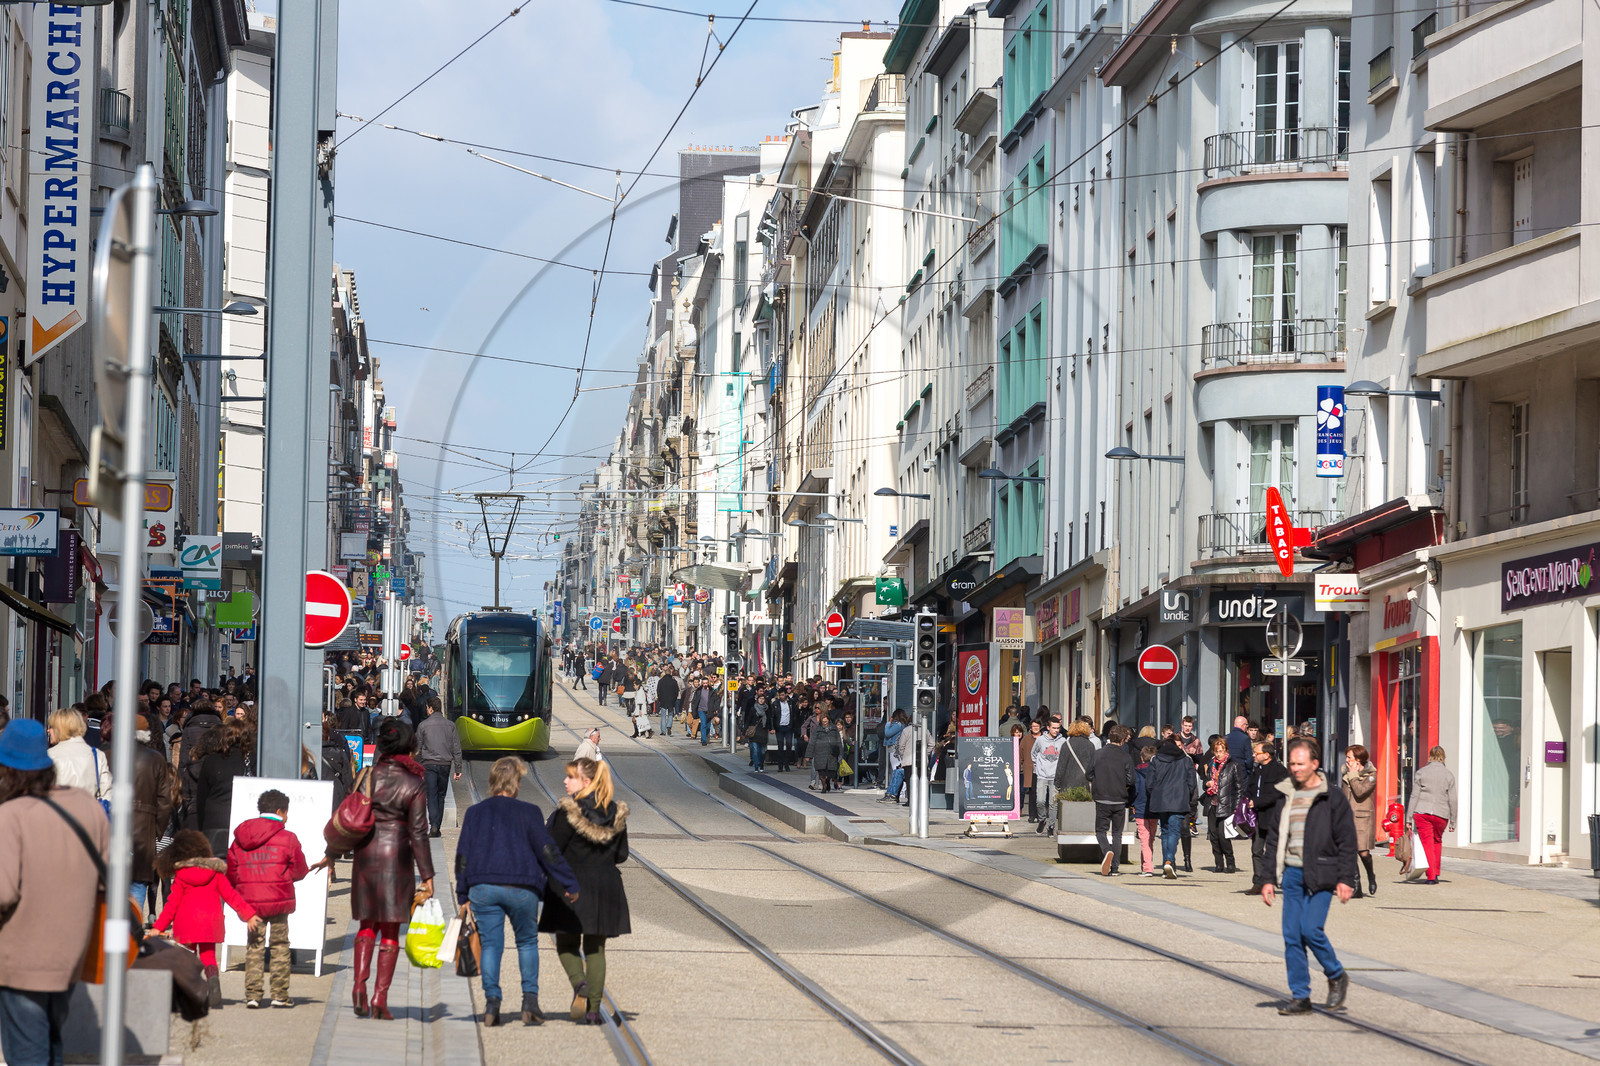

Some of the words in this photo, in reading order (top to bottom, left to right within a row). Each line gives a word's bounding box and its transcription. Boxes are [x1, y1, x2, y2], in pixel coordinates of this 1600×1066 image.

[721, 387, 737, 498] PRINTEMPS
[1271, 505, 1289, 559] TABAC
[951, 579, 976, 589] éram
[1218, 593, 1278, 619] undiz
[1163, 611, 1189, 621] undiz
[1292, 684, 1316, 696] undi
